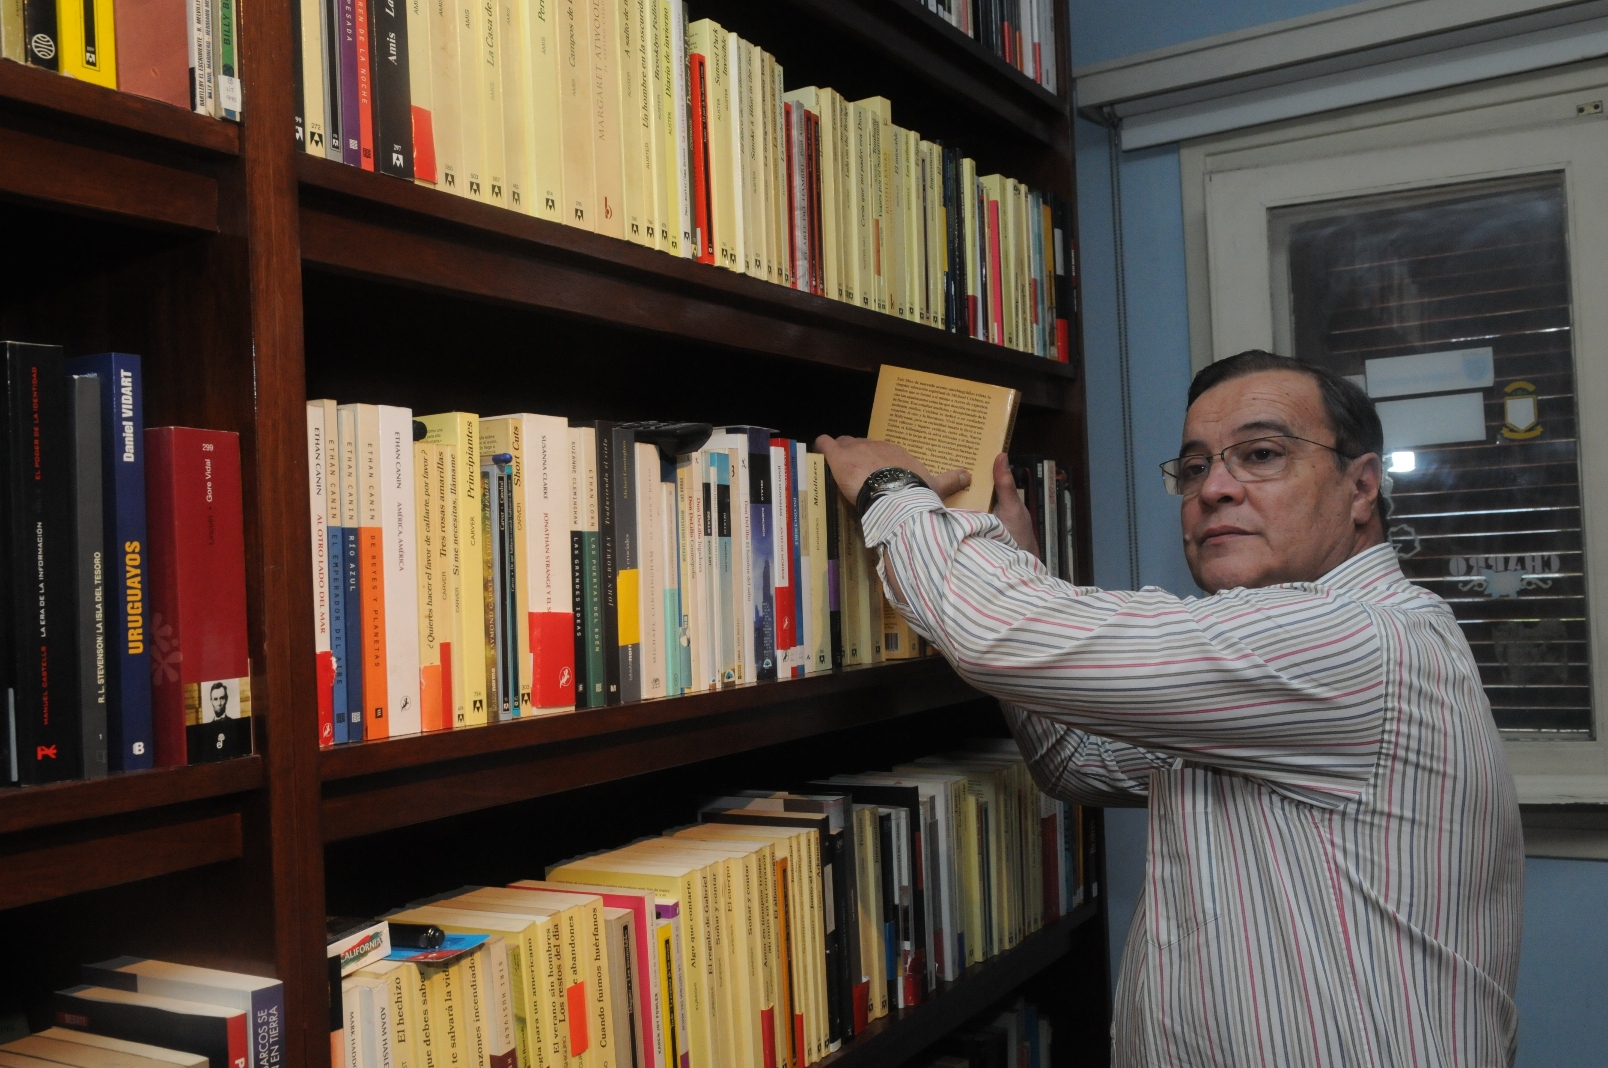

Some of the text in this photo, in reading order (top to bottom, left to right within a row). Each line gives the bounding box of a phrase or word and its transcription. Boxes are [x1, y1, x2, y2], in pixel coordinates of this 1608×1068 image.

[485, 2, 493, 14] de
[567, 6, 574, 21] de
[623, 8, 629, 21] de
[358, 28, 365, 41] DE
[485, 24, 494, 50] Casa
[568, 23, 576, 67] Campos
[360, 48, 366, 61] LA
[386, 32, 398, 66] Amis
[486, 53, 495, 67] La
[624, 49, 630, 58] A
[639, 45, 646, 55] la
[664, 50, 670, 64] de
[641, 56, 646, 69] en
[360, 68, 368, 104] NOCHE
[595, 64, 605, 141] MARGARET
[642, 113, 649, 129] Un
[31, 366, 39, 411] IDENTIDAD
[32, 413, 39, 423] LA
[33, 426, 40, 437] DE
[512, 426, 520, 451] Cuts
[202, 443, 214, 452] 299
[328, 439, 336, 476] ETHAN
[465, 420, 476, 499] Principiantes
[35, 469, 41, 480] EL
[436, 451, 445, 502] amarillas
[449, 453, 457, 495] llámame
[121, 369, 144, 655] URUGUAYOS Daniel VIDART
[316, 514, 323, 525] AL
[396, 501, 404, 536] AMÉRICA,
[423, 498, 431, 535] callarte,
[438, 504, 446, 533] rosas
[451, 498, 459, 545] necesitas,
[36, 521, 44, 580] INFORMACIÓN
[331, 534, 338, 546] EL
[370, 535, 377, 548] DE
[424, 535, 431, 543] de
[439, 535, 447, 558] Tres
[453, 547, 459, 559] me
[93, 551, 102, 584] TESORO
[425, 572, 432, 580] el
[453, 564, 460, 576] Si
[38, 582, 45, 593] LA
[332, 554, 340, 621] EMPERADOR
[38, 595, 45, 607] DE
[95, 603, 103, 621] ISLA
[40, 627, 47, 638] LA
[95, 622, 103, 633] LA
[334, 629, 342, 649] DEL
[427, 608, 435, 649] ¿Quieres
[41, 645, 49, 688] CASTELLS
[96, 634, 105, 684] STEVENSON/
[335, 657, 343, 685] AIRE
[97, 685, 105, 694] L.
[97, 694, 106, 703] R.
[686, 880, 694, 921] contarte
[341, 936, 383, 963] CALIFORNIA
[545, 928, 554, 977] hombres
[554, 943, 562, 960] del
[568, 916, 577, 975] abandones
[527, 938, 537, 997] americano
[592, 907, 607, 1048] Cuando fuimos huérfanos
[419, 971, 427, 1005] saber
[468, 951, 480, 1023] incendiados
[556, 964, 565, 998] restos
[258, 1009, 267, 1023] SE
[394, 977, 406, 1043] El hechizo
[441, 962, 458, 1063] te salvará la vida
[501, 993, 511, 1045] HUSTVEDT
[532, 1000, 538, 1014] un
[551, 1001, 559, 1038] verano
[269, 1005, 280, 1062] EN TIERRA
[421, 1009, 431, 1046] debes
[534, 1018, 542, 1043] para
[553, 1042, 560, 1054] El
